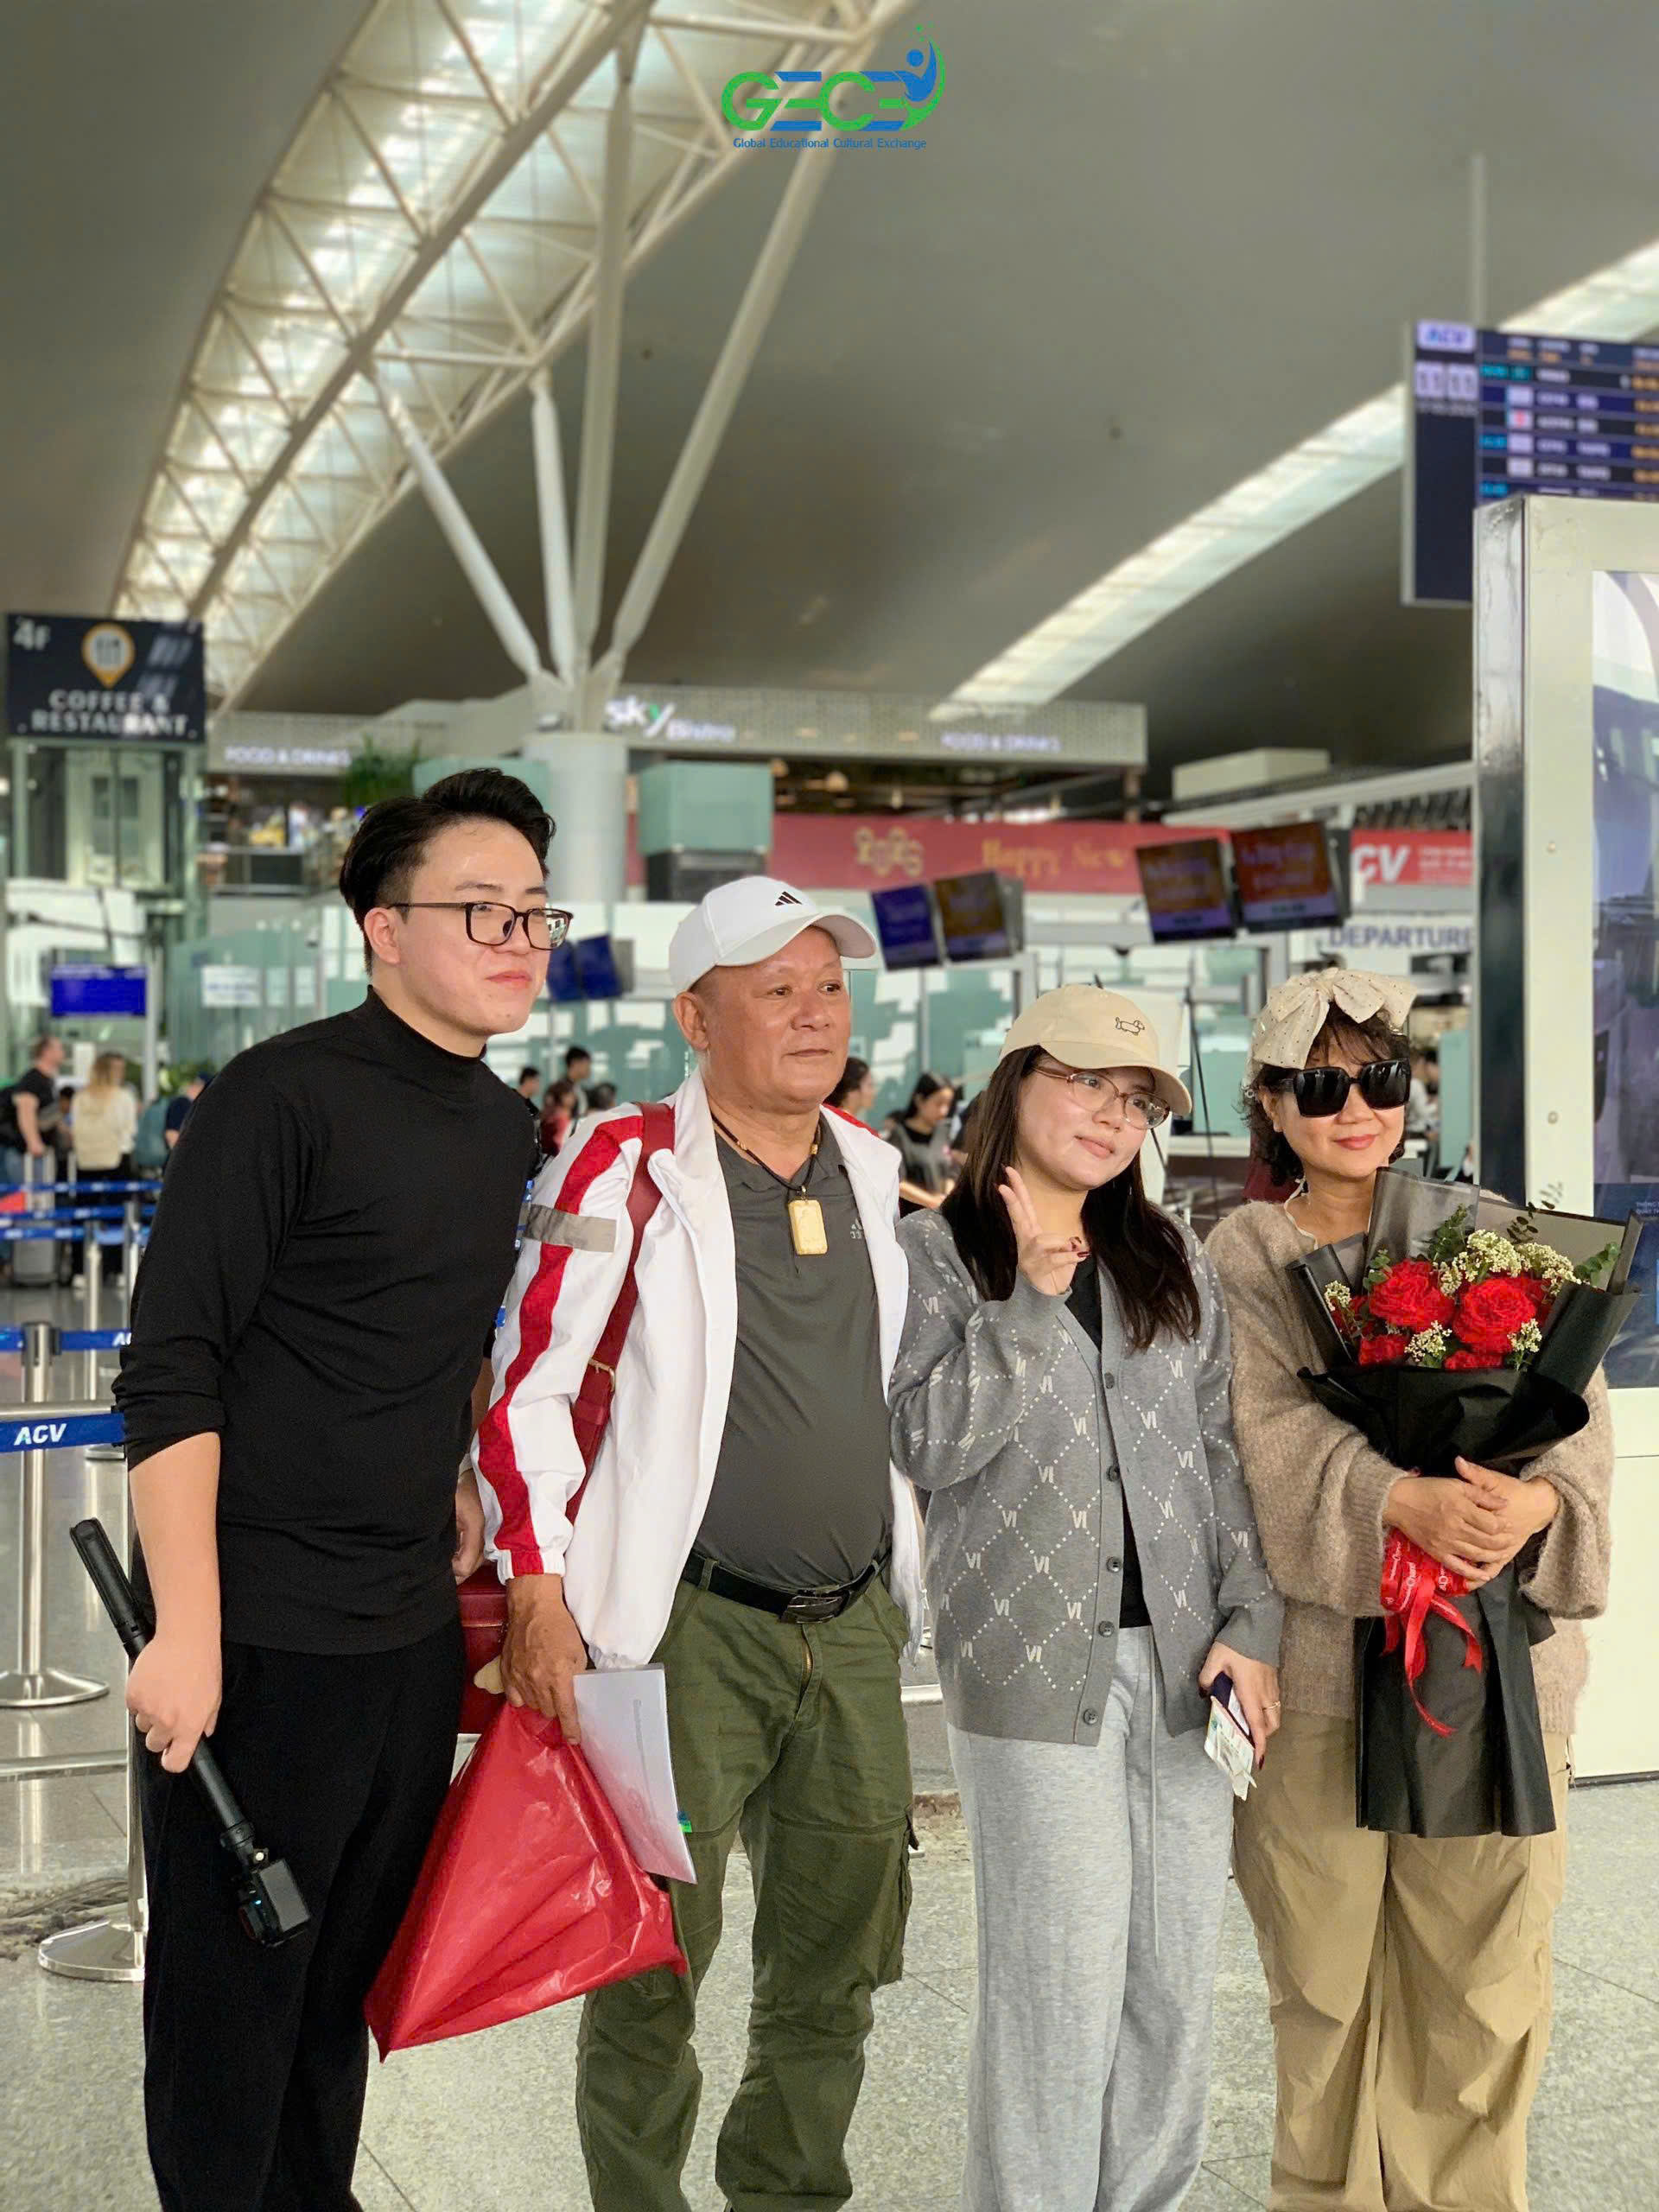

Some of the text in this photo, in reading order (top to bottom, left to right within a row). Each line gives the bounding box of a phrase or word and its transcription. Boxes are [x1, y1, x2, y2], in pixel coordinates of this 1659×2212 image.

[48, 689, 143, 713] COFFEE
[31, 710, 189, 736] RESTAURANT
[14, 1423, 67, 1446] ACV
